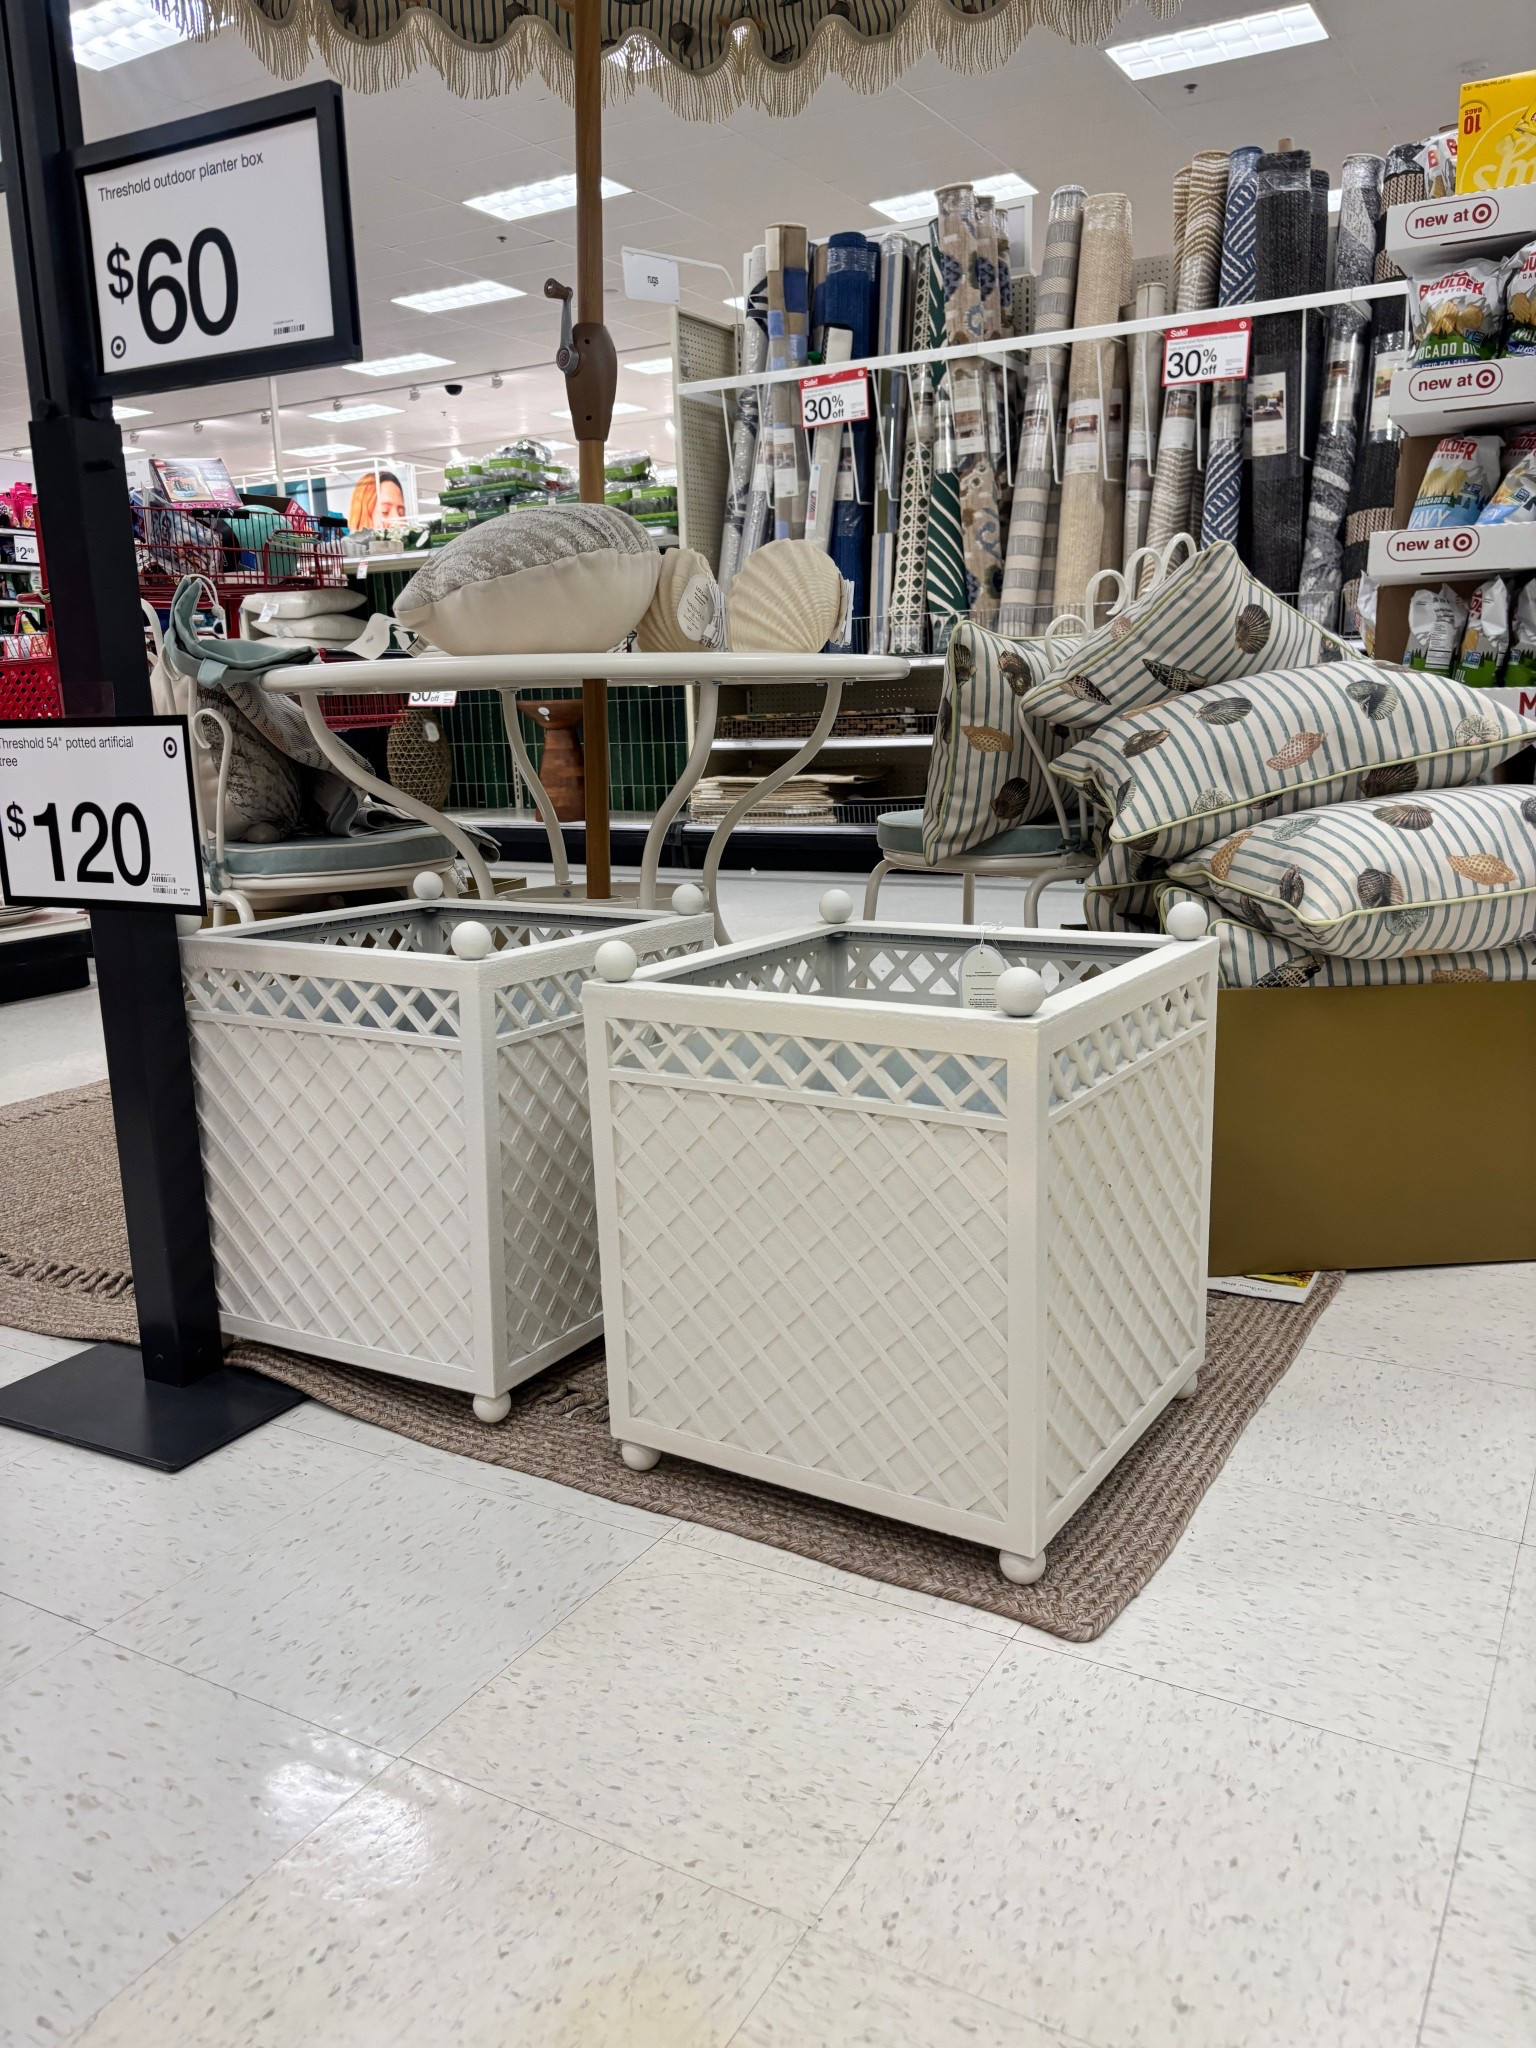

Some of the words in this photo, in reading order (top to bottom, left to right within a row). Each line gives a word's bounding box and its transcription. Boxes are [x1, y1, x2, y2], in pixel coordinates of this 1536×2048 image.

[1464, 107, 1482, 116] BAGS
[1464, 114, 1481, 135] 10
[98, 177, 152, 203] Threshold
[153, 167, 197, 192] outdoor
[199, 158, 239, 182] planter
[241, 151, 264, 169] box
[1414, 212, 1449, 229] new
[1453, 208, 1469, 222] at
[106, 226, 239, 346] $60
[647, 275, 659, 287] rugs
[1419, 276, 1485, 301] BOULDER
[1170, 328, 1189, 338] Sale!
[1463, 342, 1480, 356] OIL
[1201, 364, 1217, 376] off
[803, 378, 818, 387] Sale!
[1418, 378, 1452, 392] new
[1456, 373, 1473, 388] at
[832, 408, 844, 419] off
[1396, 538, 1429, 552] new
[1434, 536, 1450, 550] at
[66, 736, 97, 751] potted
[98, 735, 134, 749] artificial
[6, 800, 152, 887] $120
